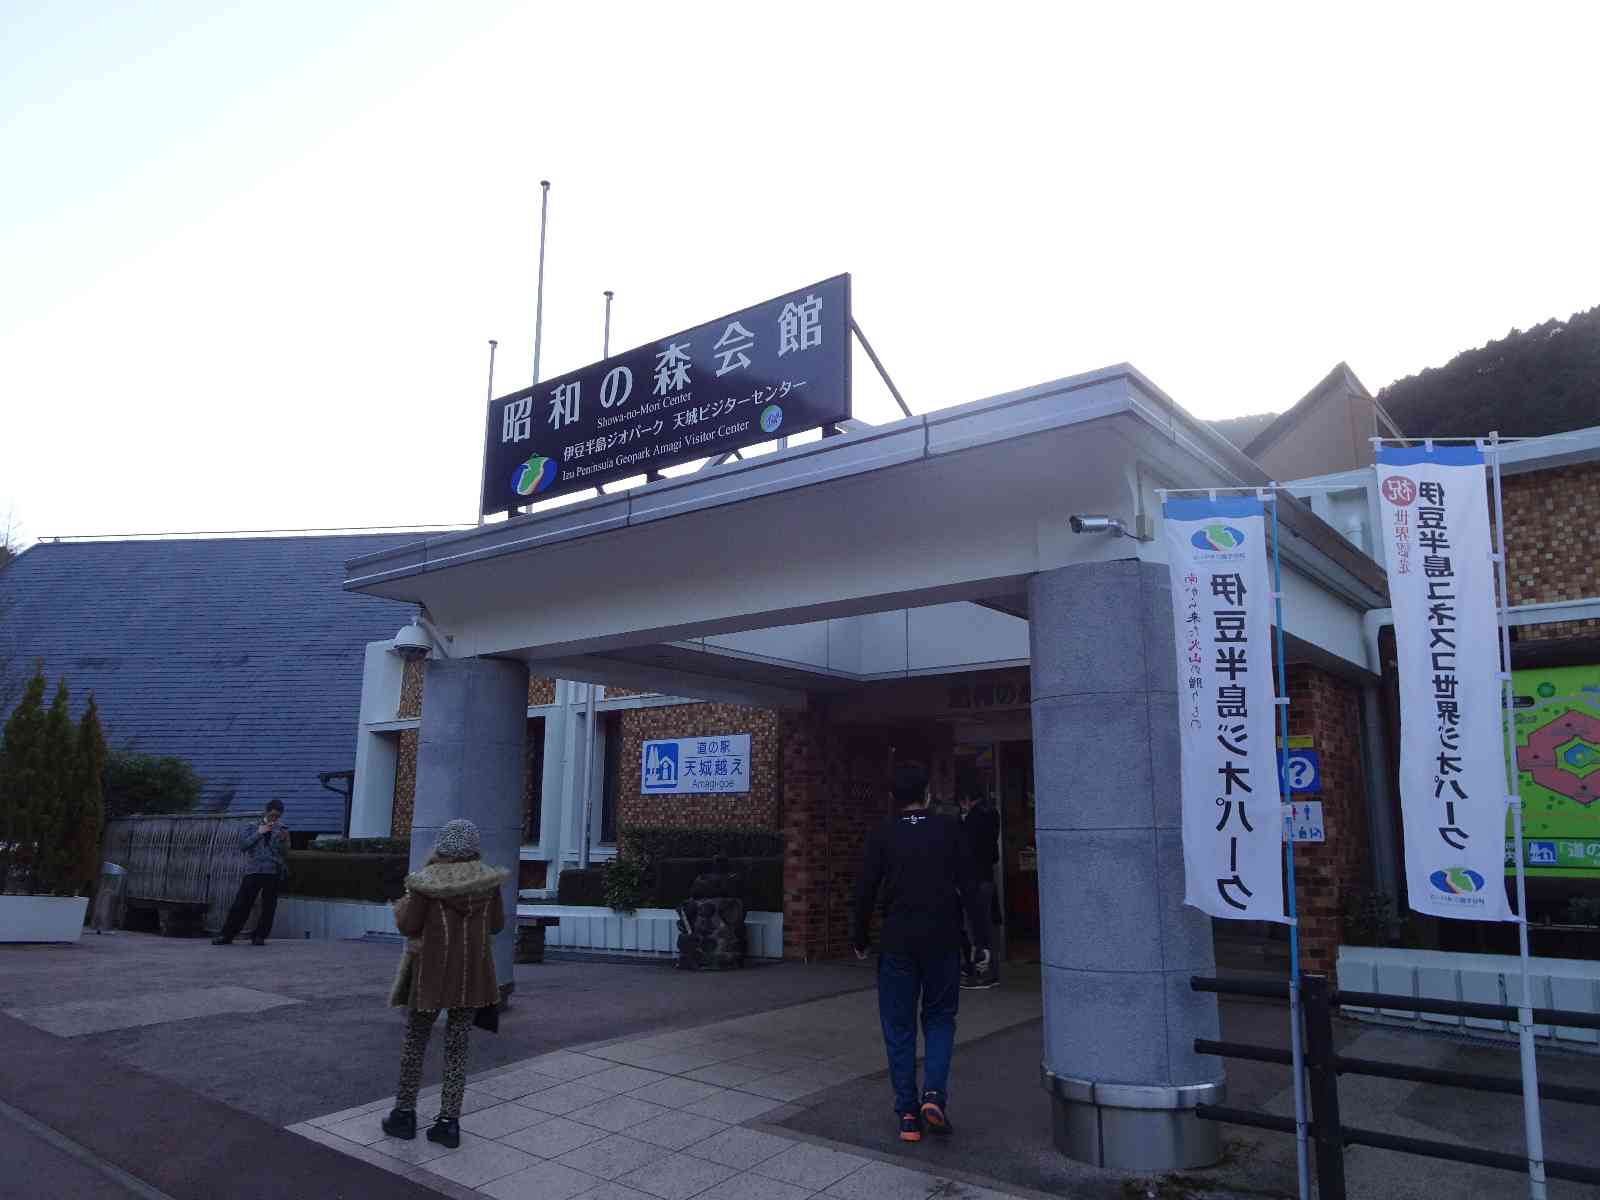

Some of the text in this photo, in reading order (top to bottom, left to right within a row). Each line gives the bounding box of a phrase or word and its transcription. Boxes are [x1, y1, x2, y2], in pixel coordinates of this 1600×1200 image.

[502, 294, 823, 444] 昭和の森会館
[564, 380, 807, 461] 伊豆半島ジオパーク 天城ビジターセンター
[597, 391, 692, 428] Showa-no-Mori Center
[562, 420, 750, 480] Izu Peninsula Geopark Amagi Visitor Center
[683, 757, 743, 776] 天城越え
[697, 740, 730, 754] 道の駅
